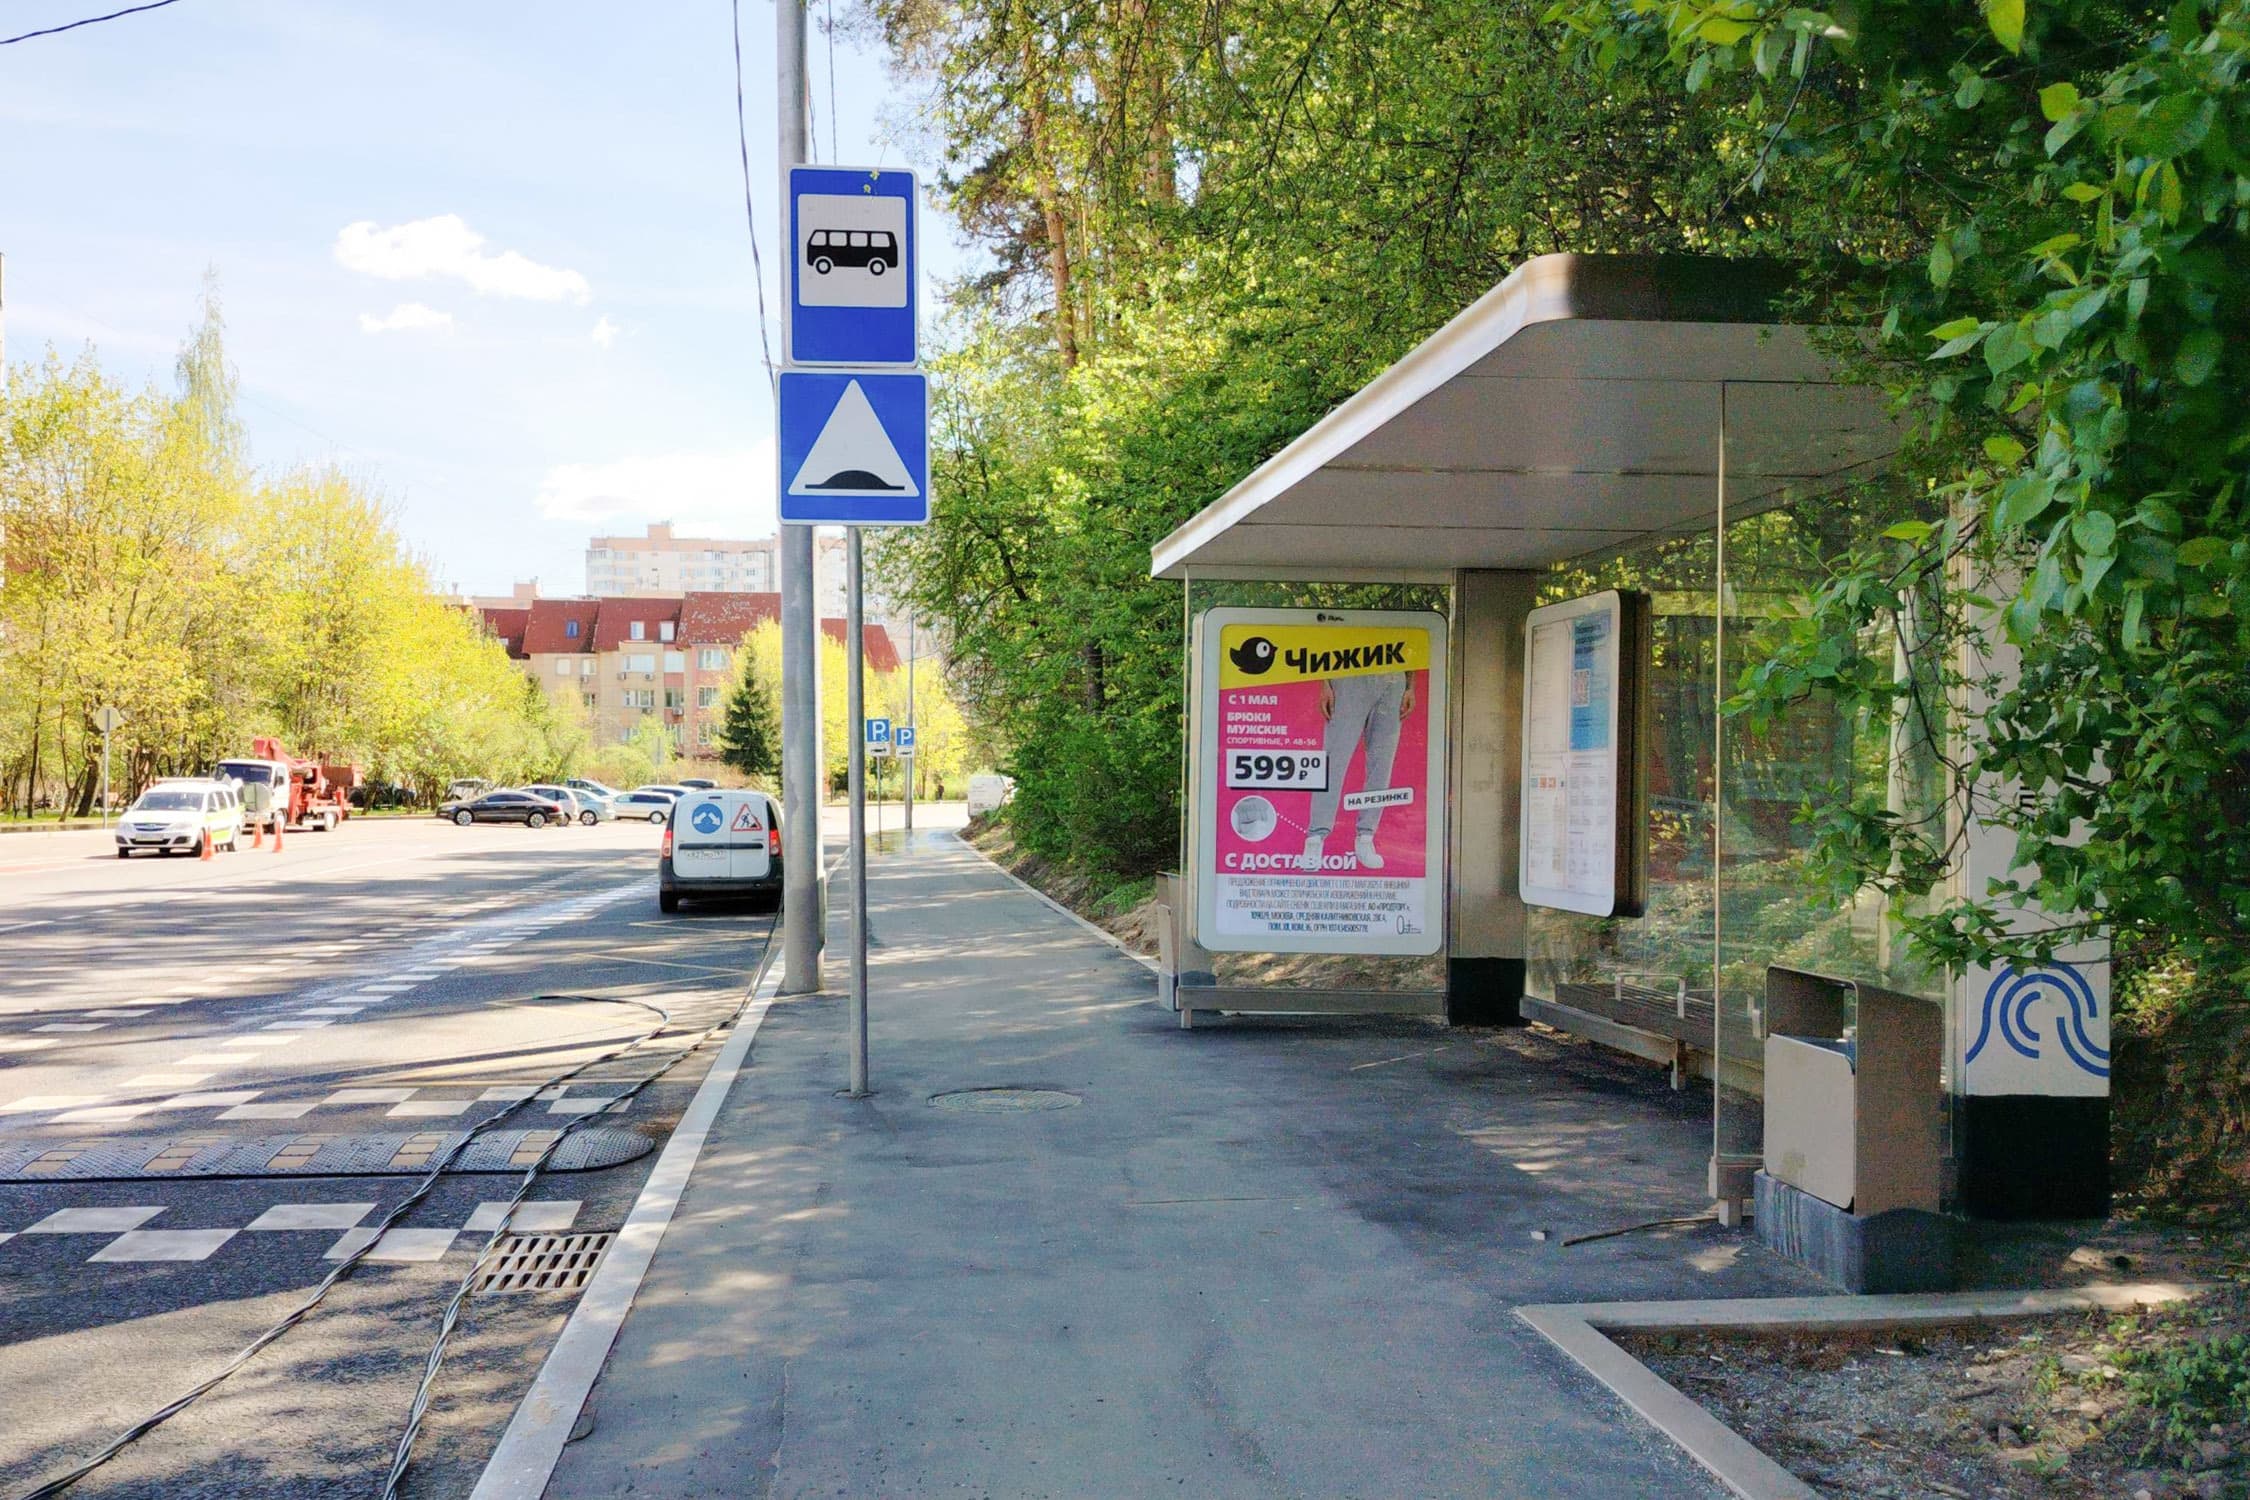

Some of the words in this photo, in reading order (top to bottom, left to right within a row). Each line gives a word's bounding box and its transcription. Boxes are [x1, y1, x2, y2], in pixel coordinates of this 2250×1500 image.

[1228, 694, 1237, 705] С
[1240, 694, 1246, 705] 1
[1248, 695, 1278, 705] МАЯ
[1226, 712, 1271, 722] БРЮКИ
[873, 721, 886, 741] P
[900, 729, 912, 745] P
[1226, 725, 1288, 735] МУЖСКИЕ
[1226, 737, 1283, 746] СПОРТИВНЫЕ,
[1235, 756, 1295, 780] 599
[1300, 757, 1320, 768] 00
[1348, 798, 1362, 806] НА
[1364, 792, 1409, 804] РЕЗИНКЕ
[1225, 854, 1237, 868] С
